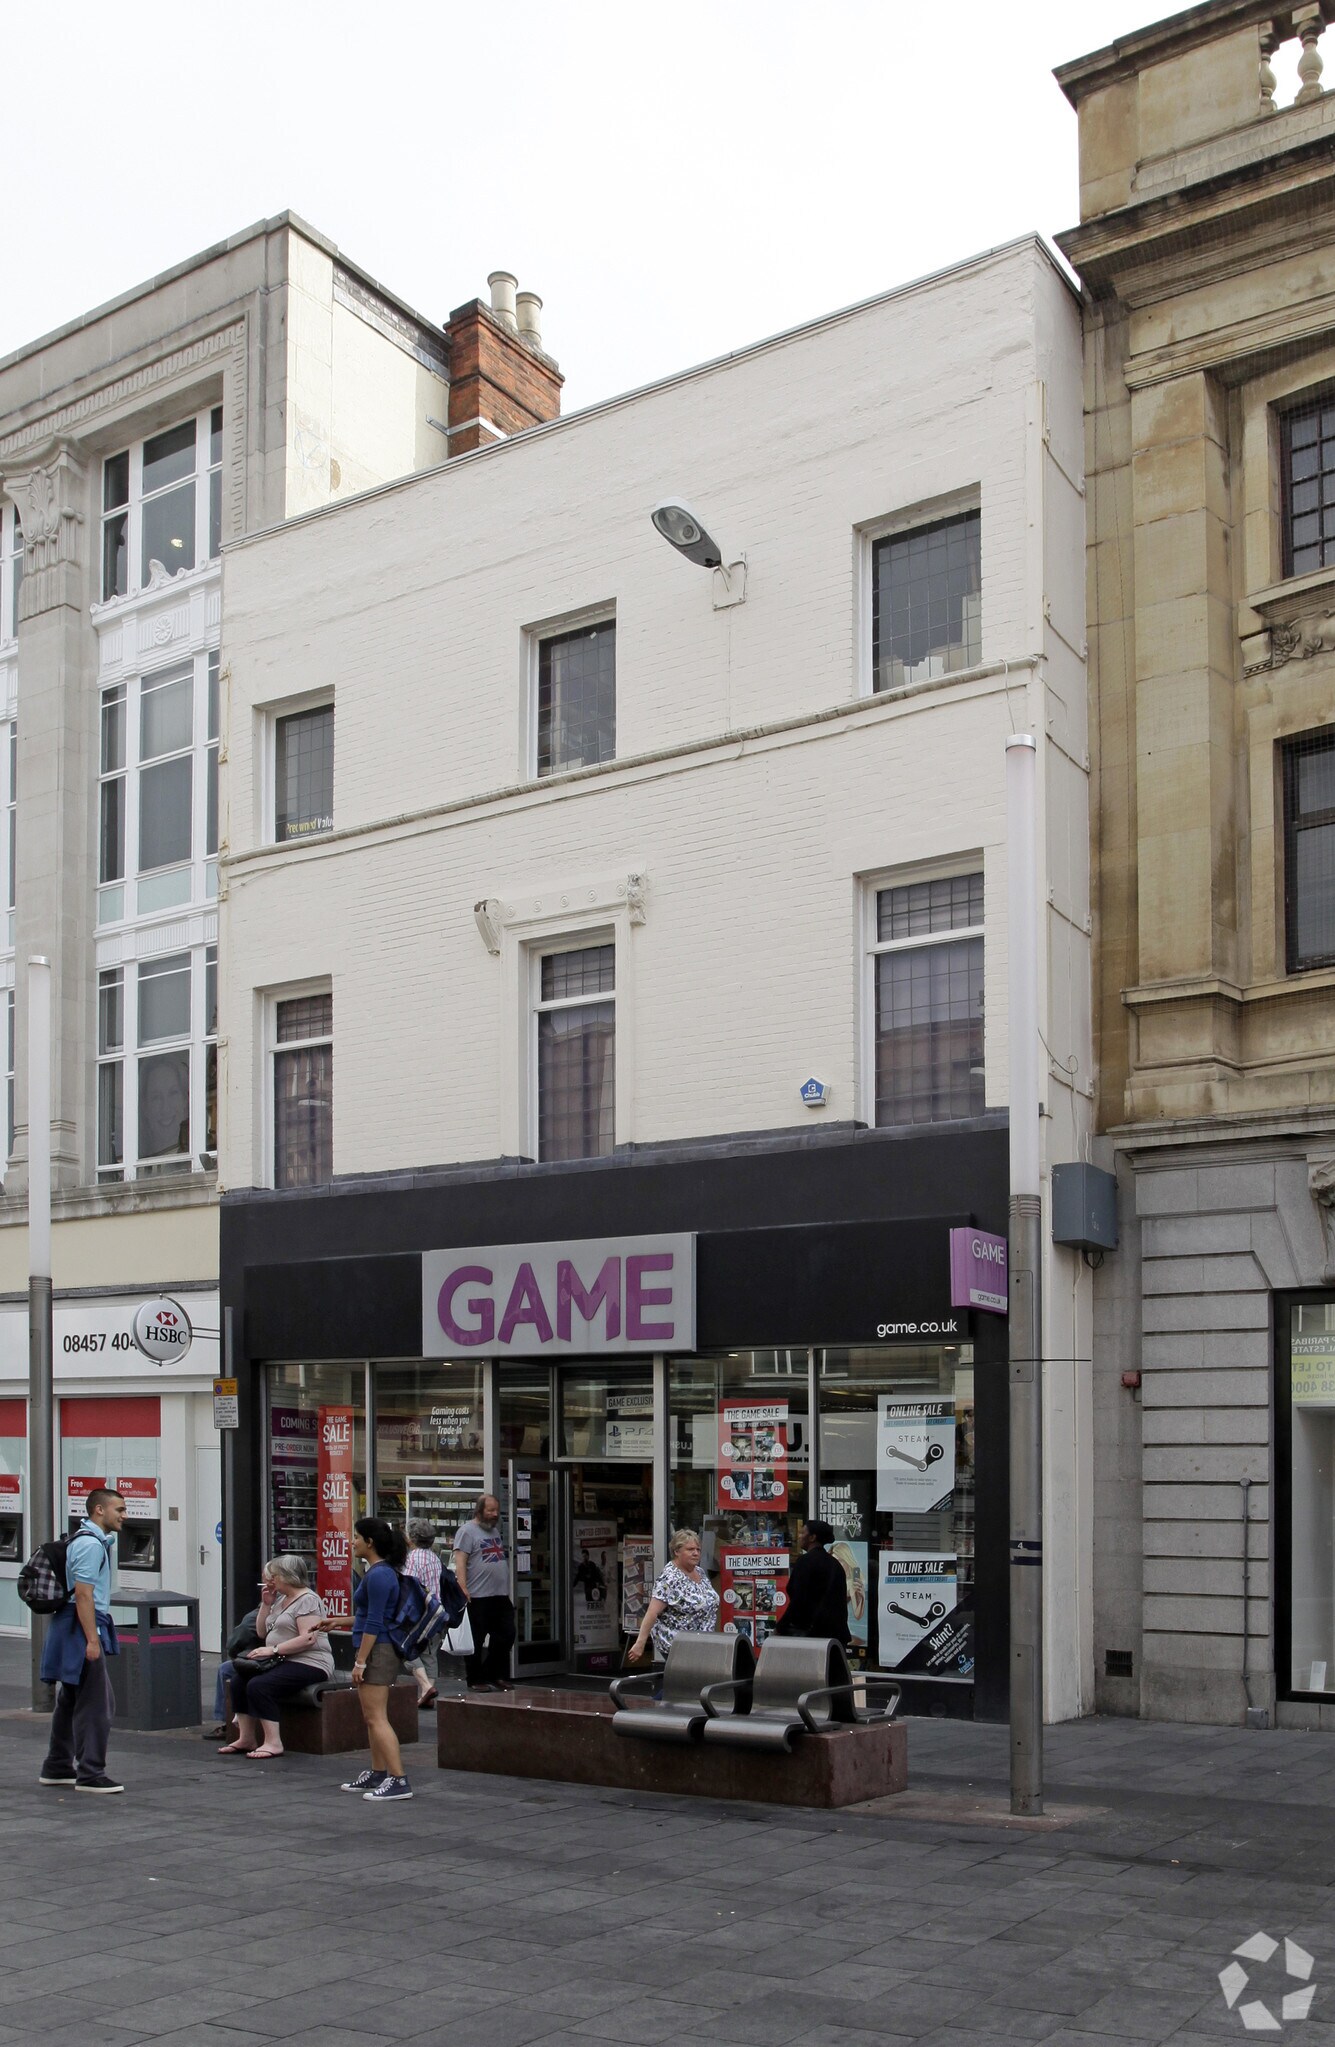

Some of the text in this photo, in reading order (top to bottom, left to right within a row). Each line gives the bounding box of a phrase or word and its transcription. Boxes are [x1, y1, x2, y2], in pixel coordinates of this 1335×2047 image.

[972, 1239, 1005, 1265] GAME
[437, 1253, 675, 1347] GAME
[978, 1294, 1000, 1304] game.co.uk
[877, 1319, 958, 1338] game.co.uk
[145, 1325, 187, 1345] HSBC
[64, 1334, 106, 1353] 08457
[609, 1398, 625, 1407] GAME
[432, 1407, 455, 1417] Gaming
[727, 1408, 779, 1420] THE GAME SALE
[890, 1404, 943, 1417] ONLINE SALE
[281, 1417, 310, 1430] COMING
[430, 1417, 469, 1426] less when you
[323, 1424, 350, 1443] SALE
[626, 1428, 653, 1436] PS4
[275, 1443, 304, 1452] PRE-ORDER
[71, 1480, 83, 1488] Free
[120, 1480, 133, 1489] Free
[323, 1482, 350, 1500] SALE
[322, 1540, 349, 1558] SALE
[729, 1557, 780, 1567] THE GAME SALE
[892, 1562, 944, 1574] ONLINE SALE
[900, 1592, 932, 1600] STEAM
[322, 1598, 348, 1616] SALE
[930, 1623, 955, 1650] Skint?
[591, 1656, 608, 1664] GAME
